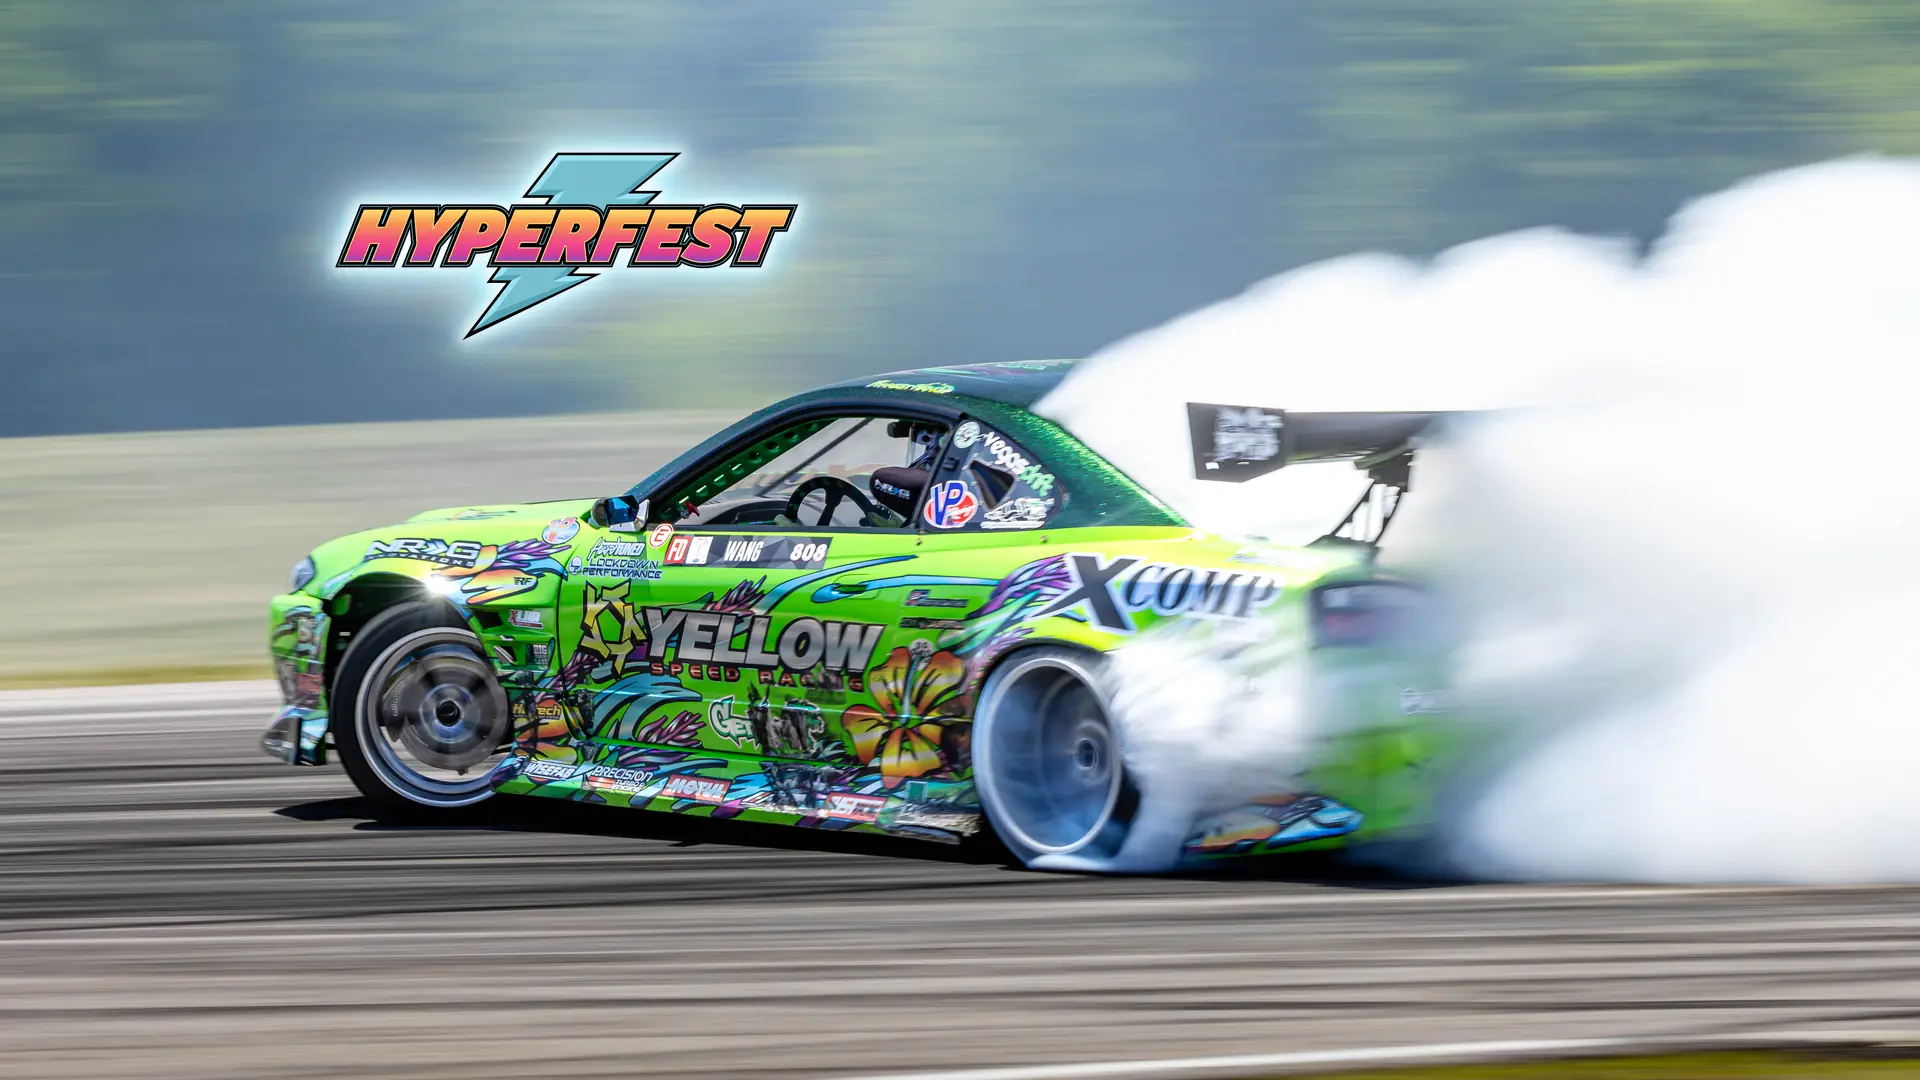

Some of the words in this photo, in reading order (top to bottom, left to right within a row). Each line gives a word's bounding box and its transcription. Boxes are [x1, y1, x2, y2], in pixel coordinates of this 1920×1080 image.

[667, 538, 689, 561] FD
[724, 540, 764, 562] WANG
[789, 543, 828, 562] 808
[582, 567, 663, 579] PERFORMANCE
[589, 557, 659, 570] LOCKDOWN
[642, 606, 887, 674] YELLOW
[650, 662, 741, 682] SPEED
[525, 762, 576, 779] WISEFAB
[668, 777, 724, 798] MOTUL
